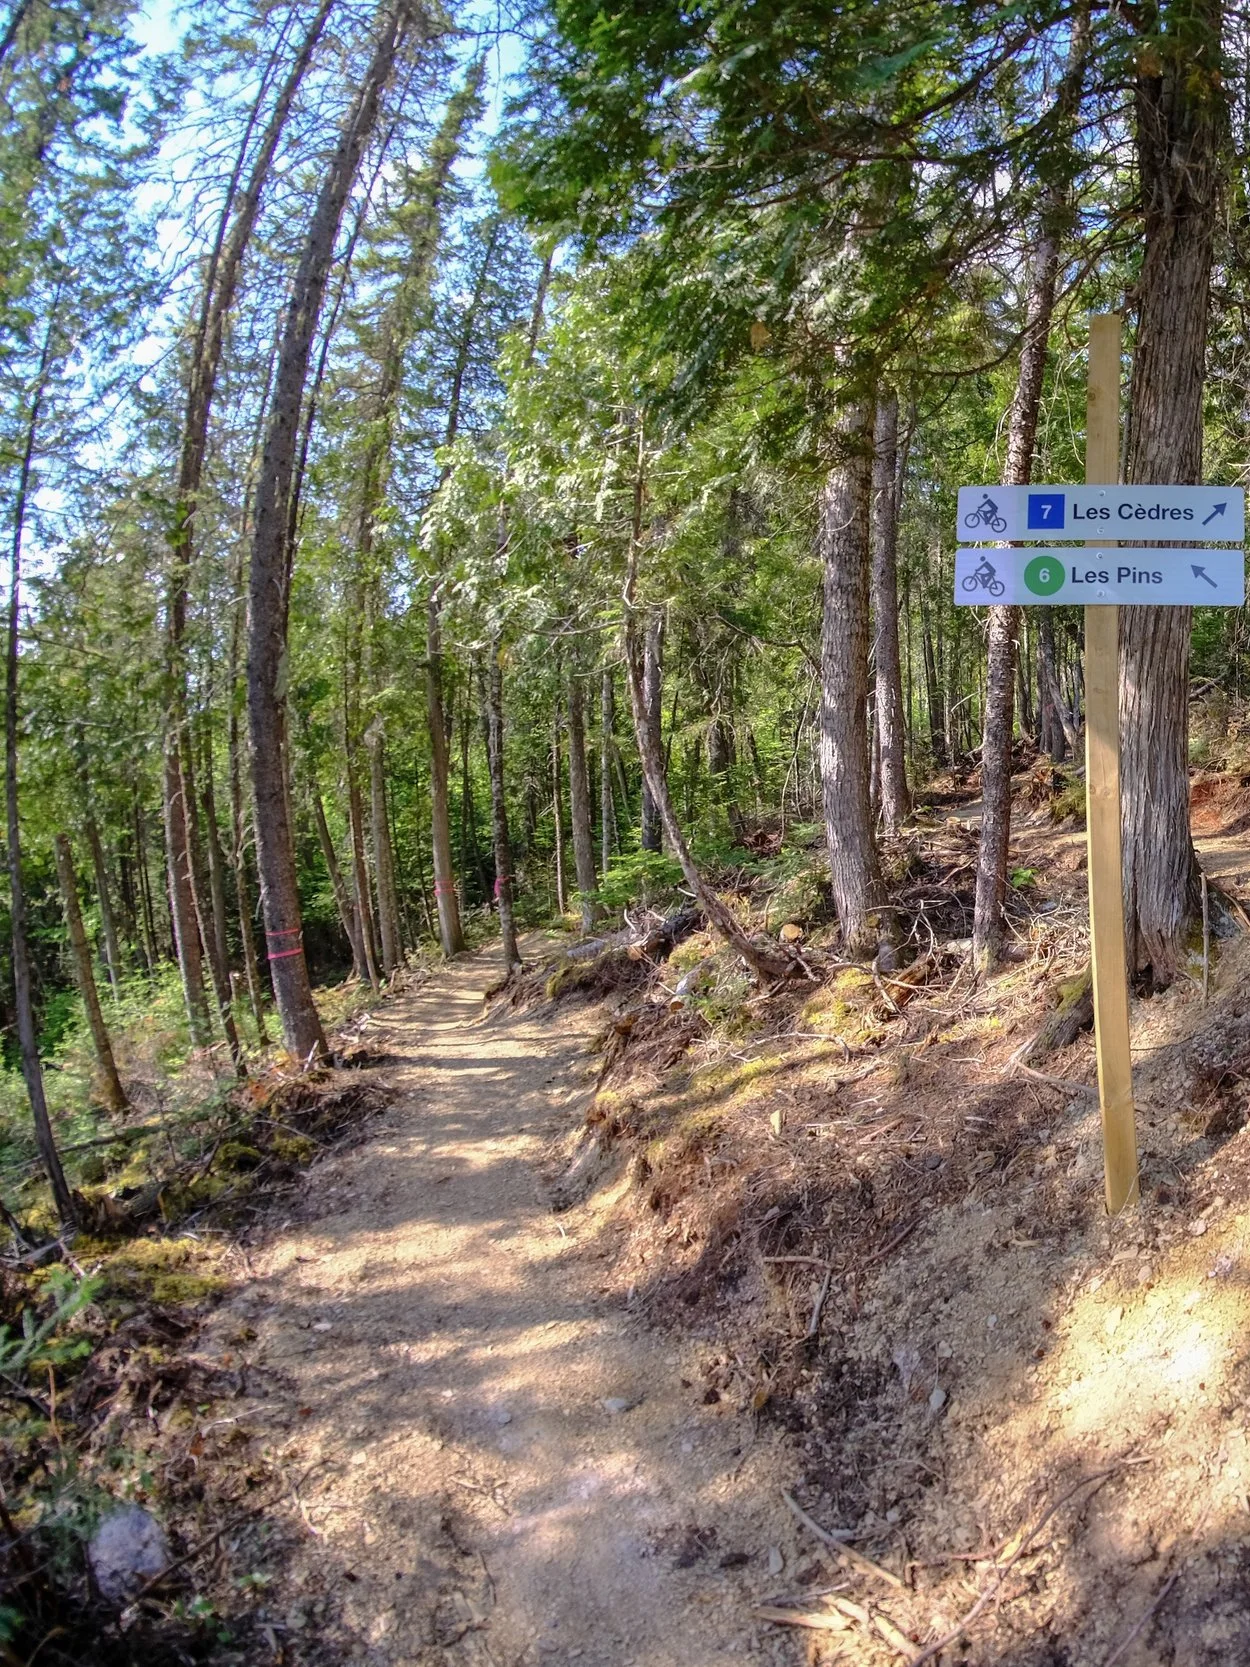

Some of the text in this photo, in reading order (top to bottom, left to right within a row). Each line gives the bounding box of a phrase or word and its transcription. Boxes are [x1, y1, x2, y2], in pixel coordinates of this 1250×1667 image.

[1040, 503, 1194, 521] 7 Les Cèdres
[1039, 566, 1163, 584] 6 Les Pins
